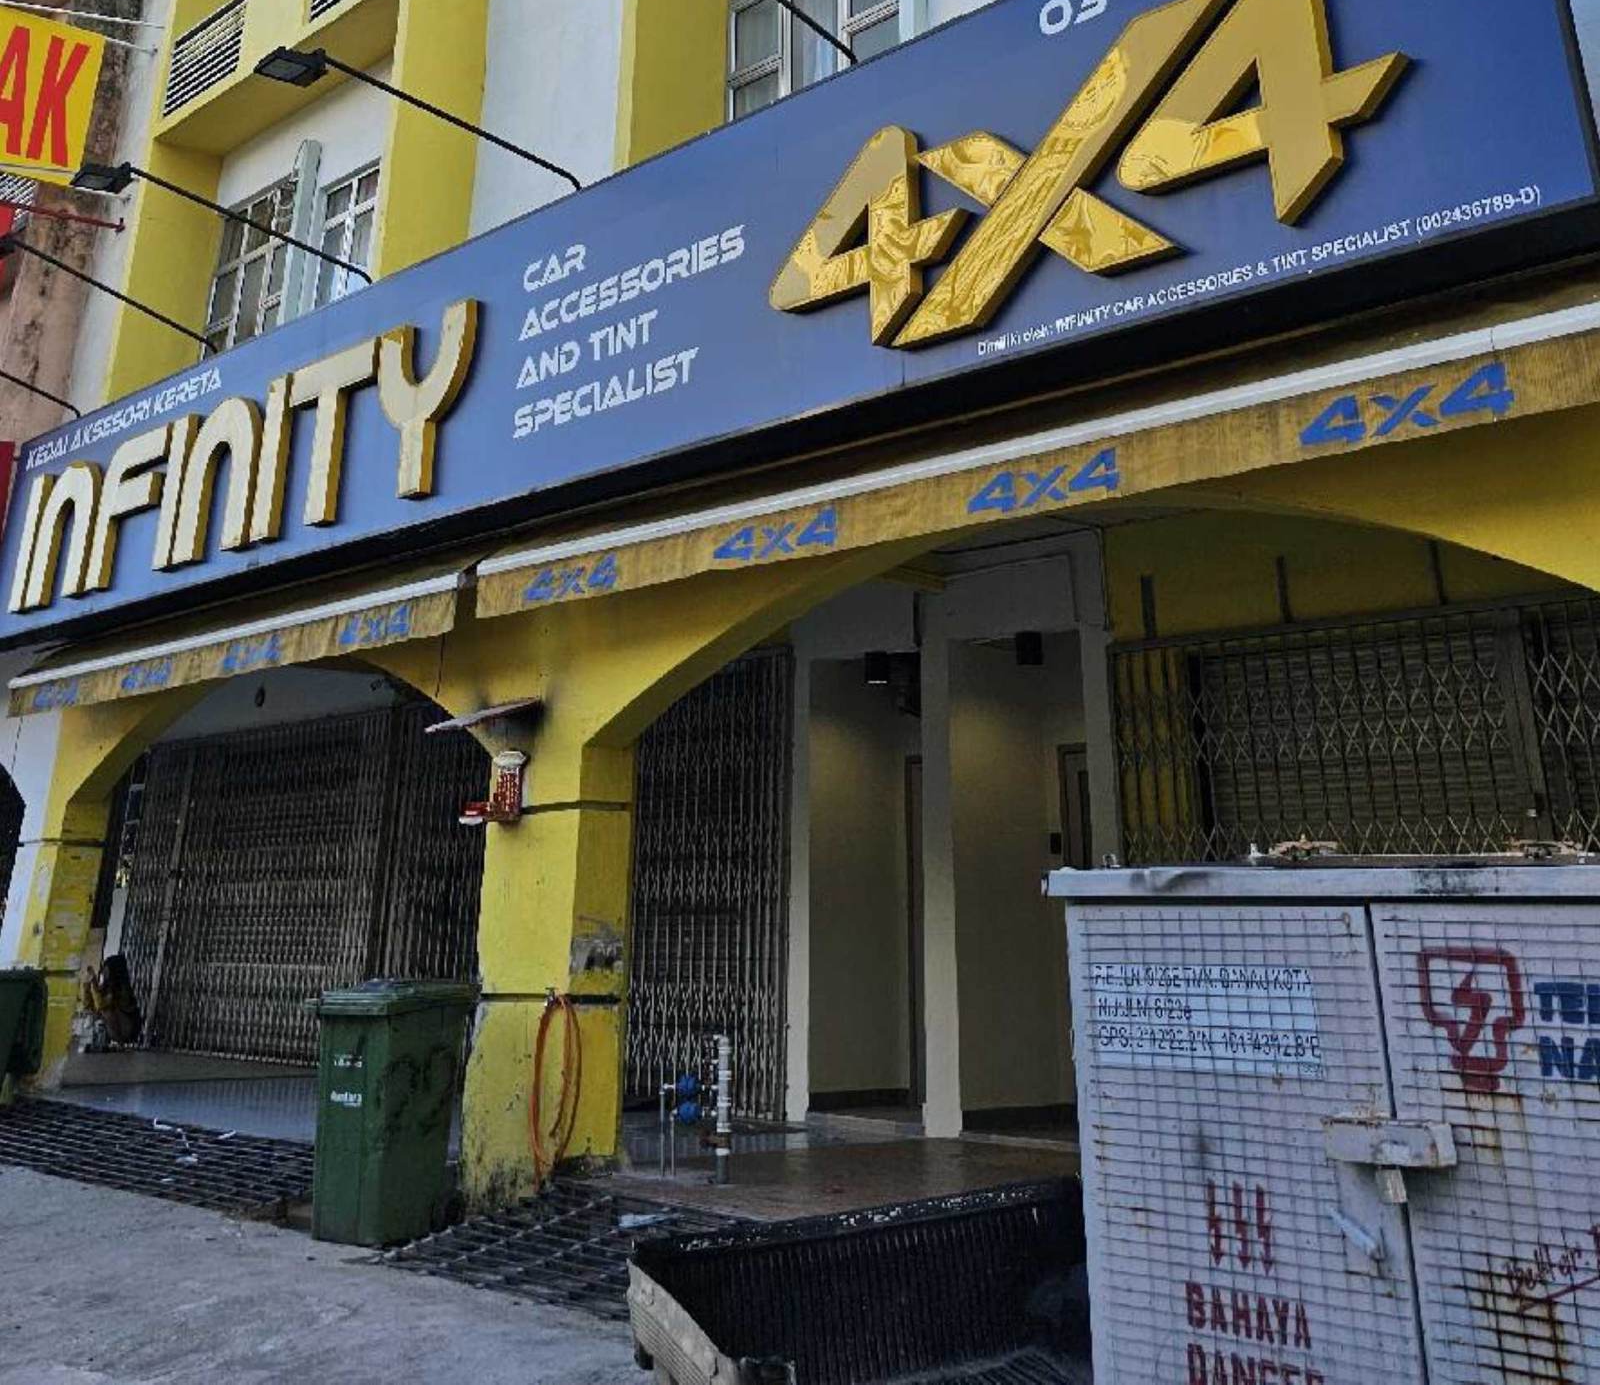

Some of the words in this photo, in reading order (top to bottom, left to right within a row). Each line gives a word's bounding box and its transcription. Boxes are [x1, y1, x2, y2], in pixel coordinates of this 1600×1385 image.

[519, 224, 746, 342] ACCESSORIES
[523, 243, 587, 292] CAR
[1055, 303, 1112, 334] INFINITY
[1113, 295, 1144, 316] CAR
[1146, 264, 1251, 308] ACCESSORIES
[1257, 261, 1268, 276] &
[1271, 248, 1309, 273] TINT
[1311, 218, 1411, 262] SPECIALIST
[1415, 183, 1541, 236] (002436789-D)
[513, 347, 700, 439] SPECIALIST
[516, 341, 581, 390] AND
[588, 309, 658, 361] TINT
[8, 298, 478, 613] INFINITY
[26, 434, 68, 472] KEDAI
[69, 396, 152, 453] AKSESORI
[153, 366, 222, 417] KERETA
[1185, 1281, 1312, 1349] BAHAYA
